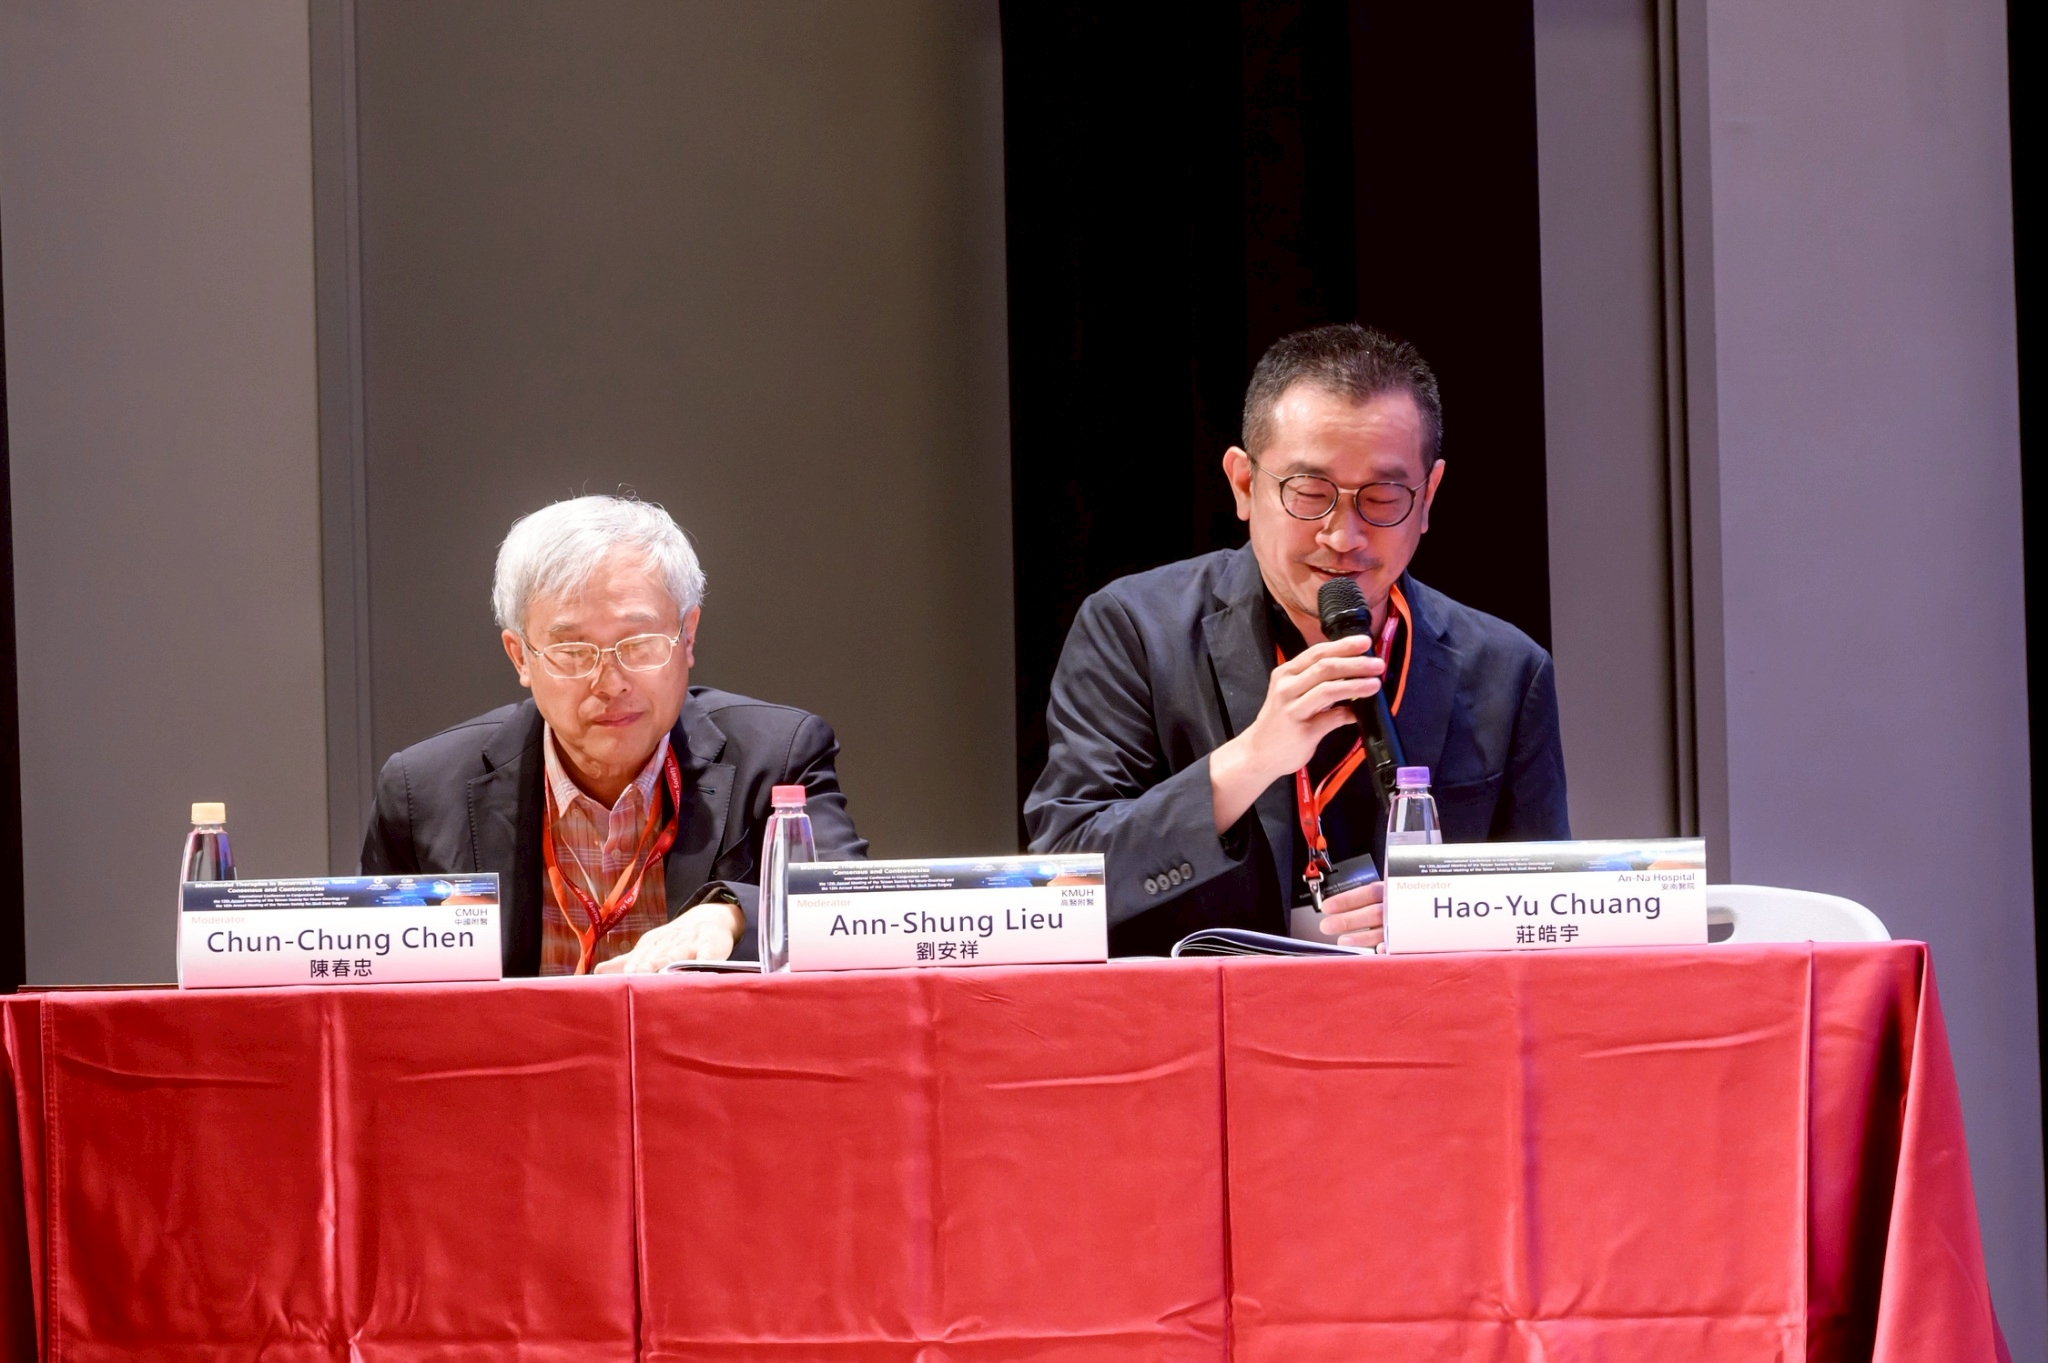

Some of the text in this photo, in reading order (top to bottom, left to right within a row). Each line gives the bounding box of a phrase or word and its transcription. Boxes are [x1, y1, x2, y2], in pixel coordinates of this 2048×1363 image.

[1618, 873, 1695, 882] An-Na Hospital
[1062, 889, 1094, 897] KMUH
[1396, 882, 1451, 890] Moderator
[797, 899, 851, 908] Moderator
[1434, 893, 1661, 919] Hao-Yu Chuang
[455, 908, 488, 917] CMUH
[191, 916, 246, 924] Moderator
[830, 908, 1064, 937] Ann-Shung Lieu
[1516, 924, 1579, 943] 莊皓宇
[207, 926, 473, 956] Chun-Chung Chen
[916, 940, 980, 960] 劉安祥
[310, 958, 373, 978] 陳春忠
